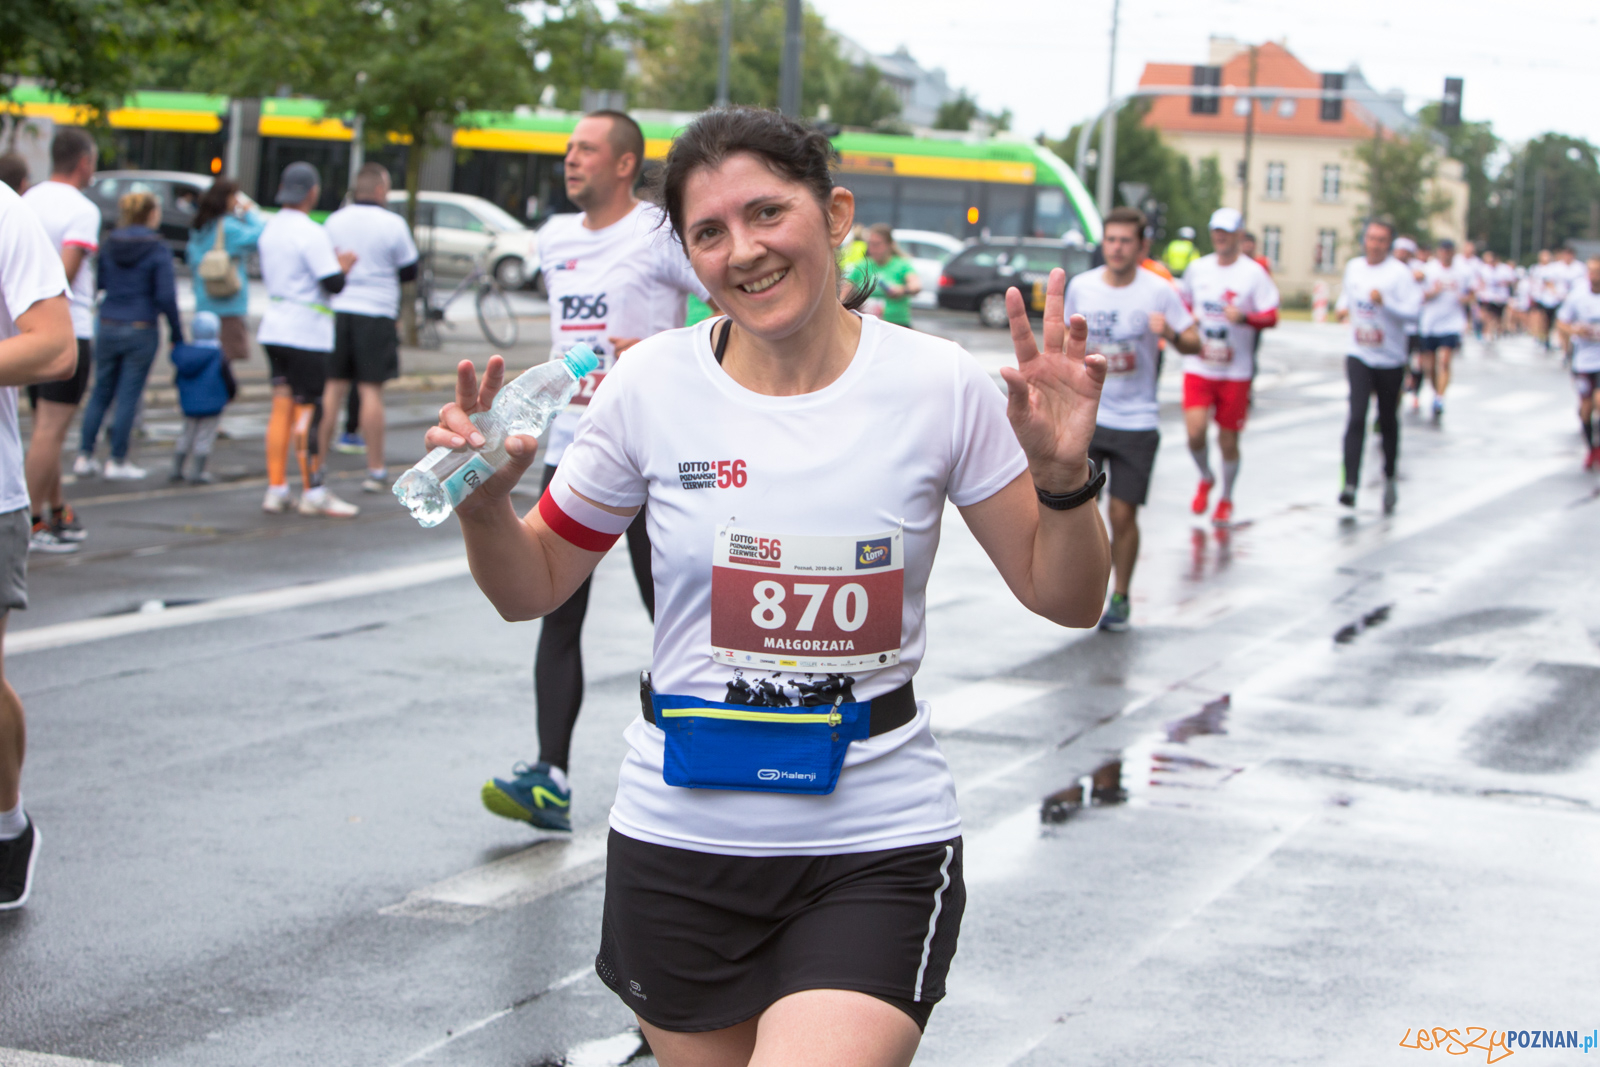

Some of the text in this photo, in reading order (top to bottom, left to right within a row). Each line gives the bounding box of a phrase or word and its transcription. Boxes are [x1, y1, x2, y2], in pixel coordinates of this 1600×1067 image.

[559, 293, 608, 320] 1956
[678, 461, 710, 473] LOTTO
[682, 480, 716, 490] CZERWIEC
[730, 533, 754, 544] LOTTO
[728, 548, 758, 558] CZERWIEC
[865, 549, 884, 561] LOTTO
[751, 580, 869, 632] 870
[763, 637, 855, 651] MAŁGORZATA
[781, 771, 817, 782] Kalenji
